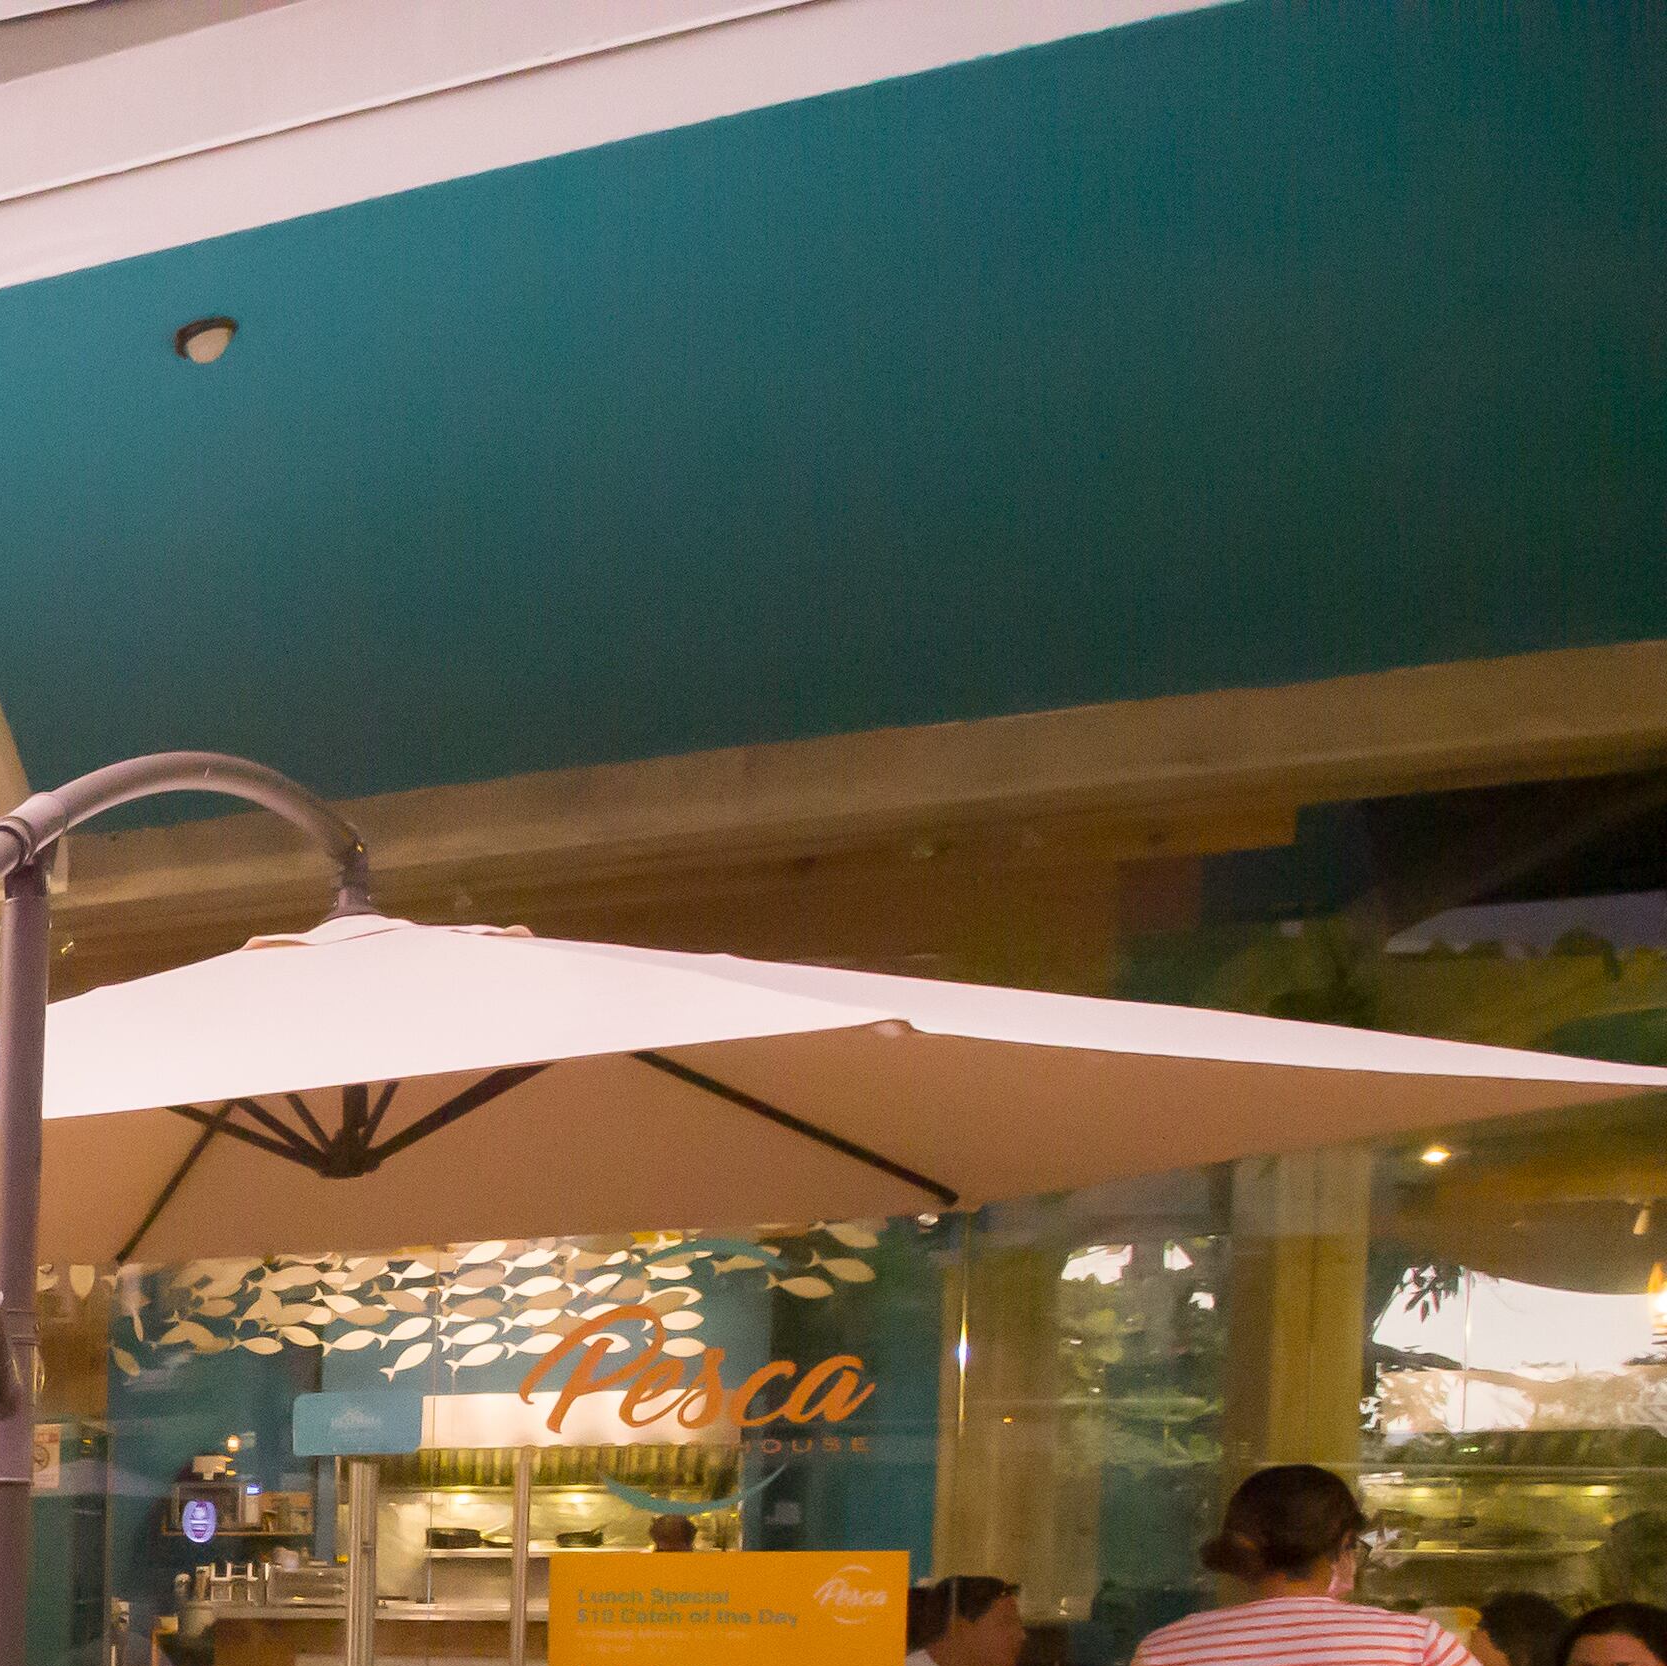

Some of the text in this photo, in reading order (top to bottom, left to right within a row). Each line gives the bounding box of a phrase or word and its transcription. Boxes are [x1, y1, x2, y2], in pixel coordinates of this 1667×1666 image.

[518, 1304, 877, 1434] Pesca
[578, 1588, 644, 1604] Lunch
[689, 1609, 711, 1625] of
[716, 1610, 752, 1625] the
[757, 1609, 798, 1629] Day
